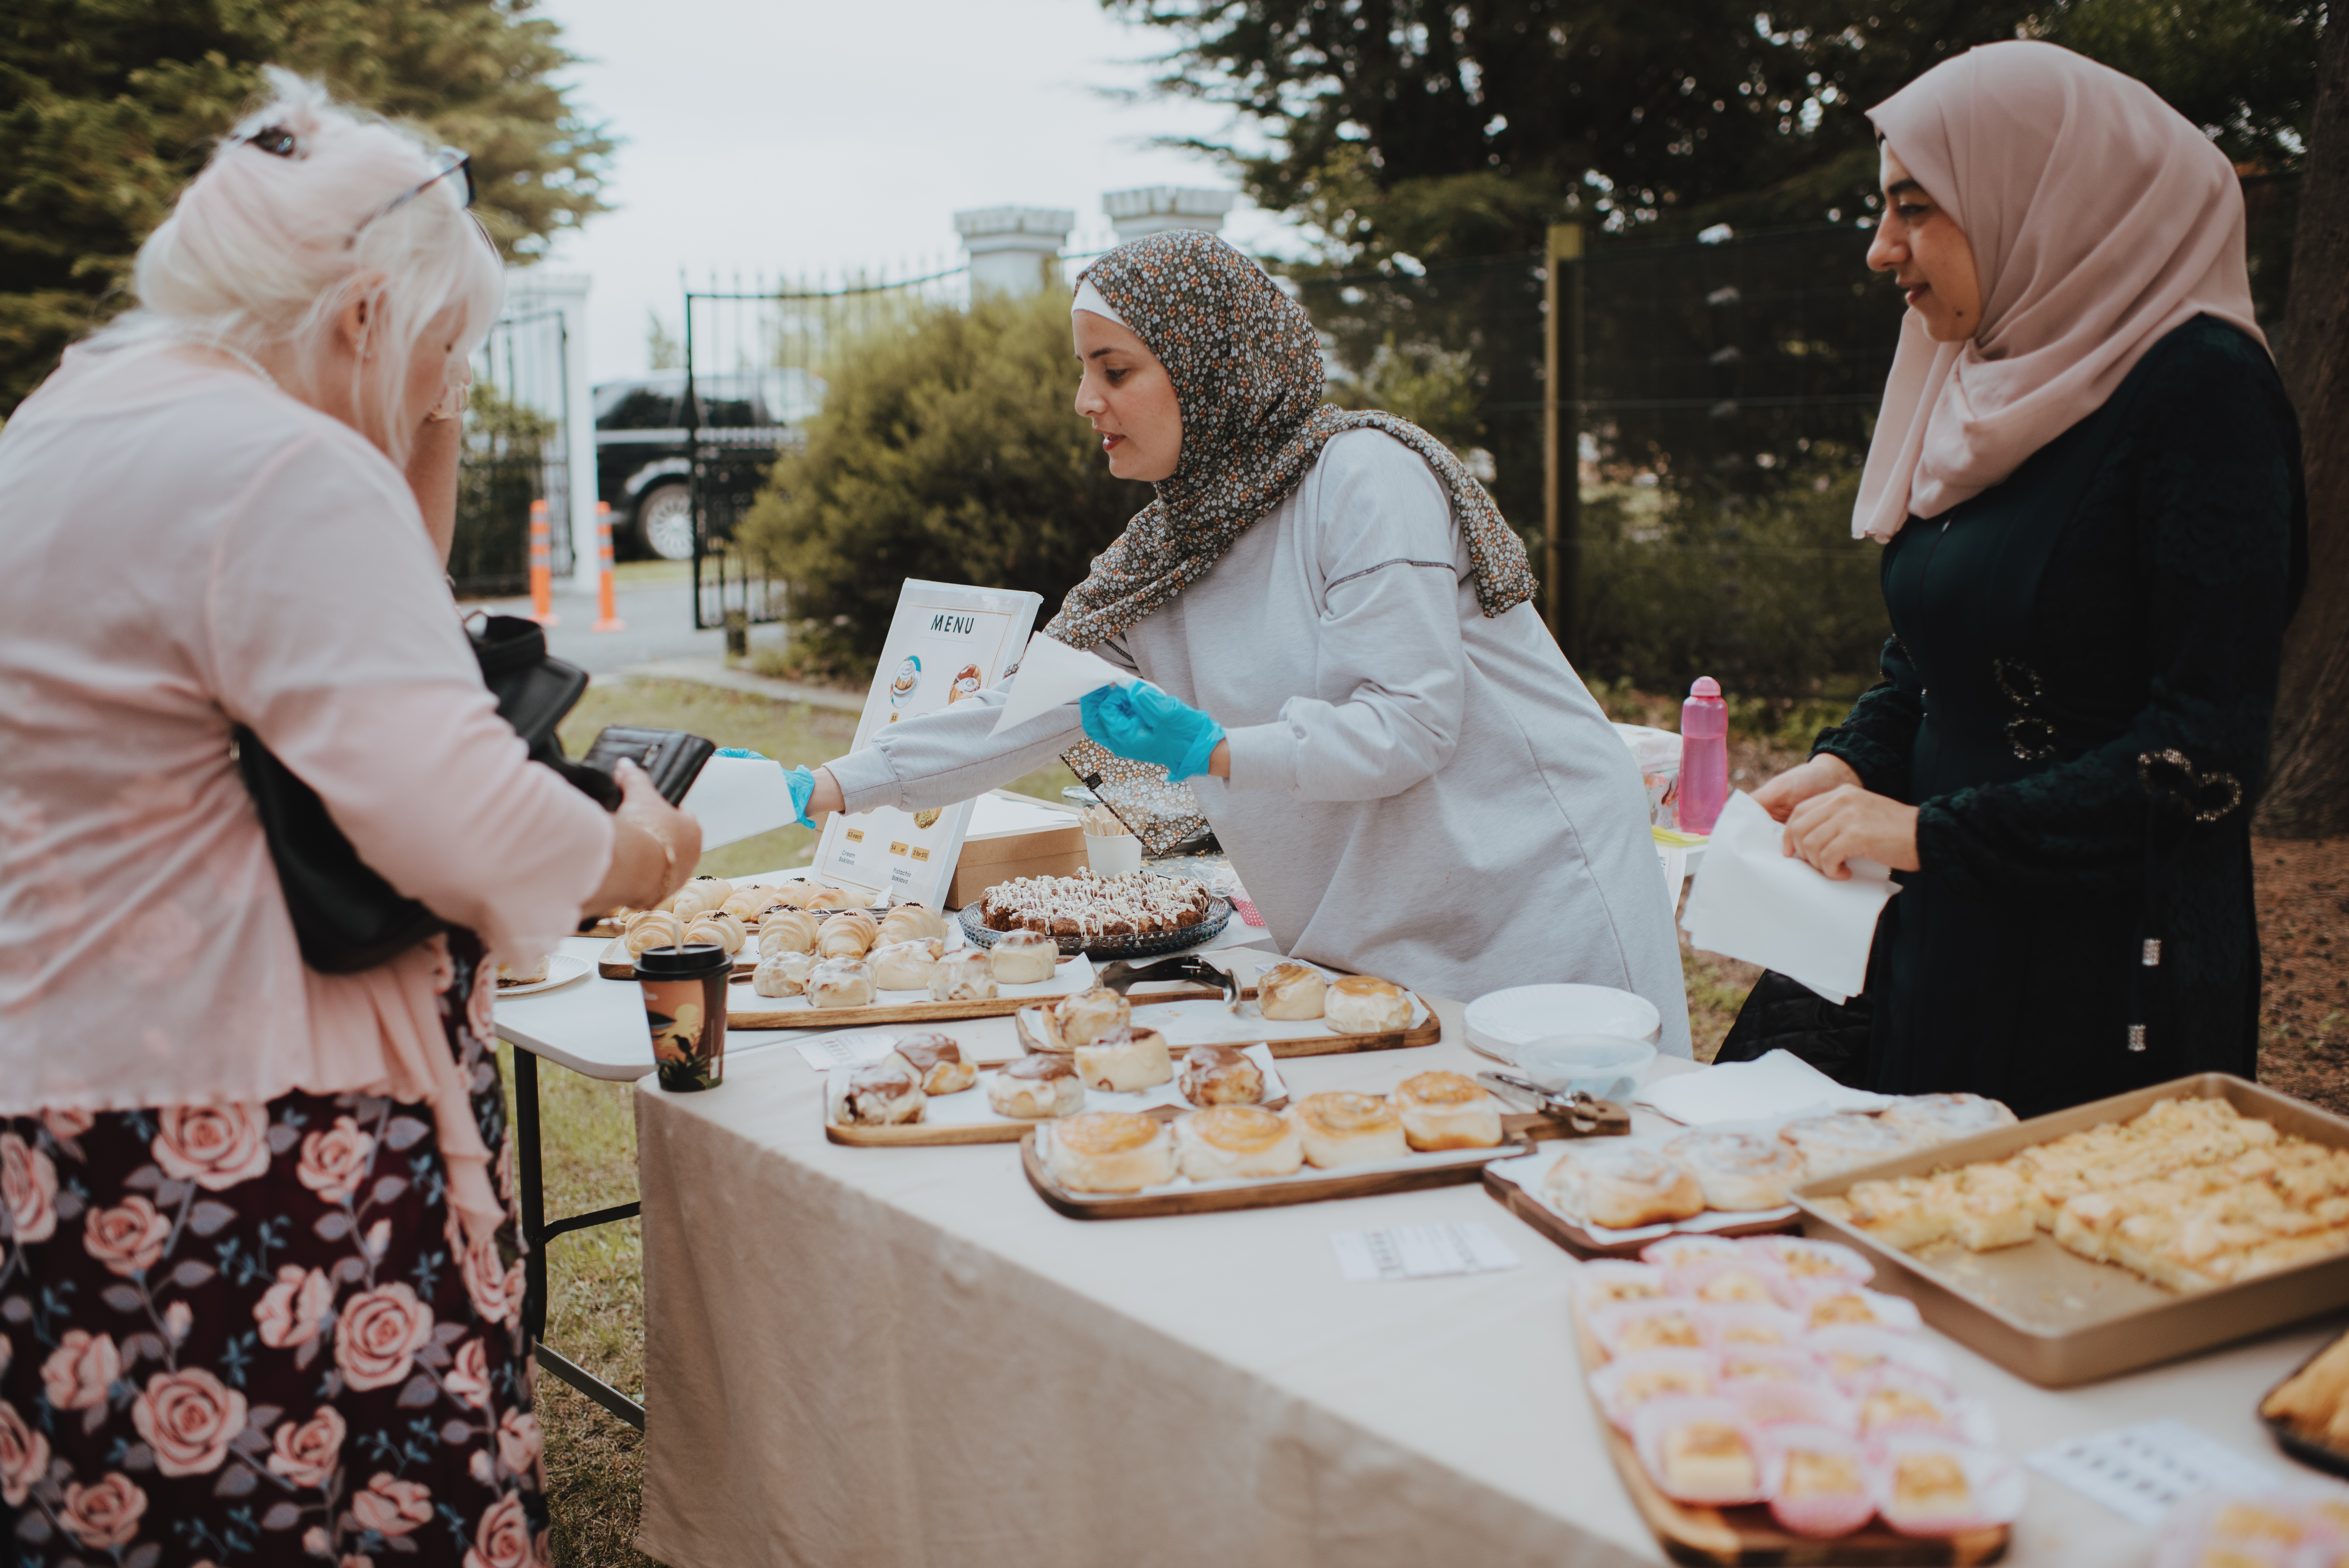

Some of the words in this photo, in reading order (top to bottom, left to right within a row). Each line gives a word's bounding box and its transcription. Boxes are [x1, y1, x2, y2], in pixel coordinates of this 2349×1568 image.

[930, 614, 974, 634] MENU
[838, 857, 854, 865] Baklava
[893, 868, 911, 877] Pistachio
[891, 875, 908, 884] Baklava
